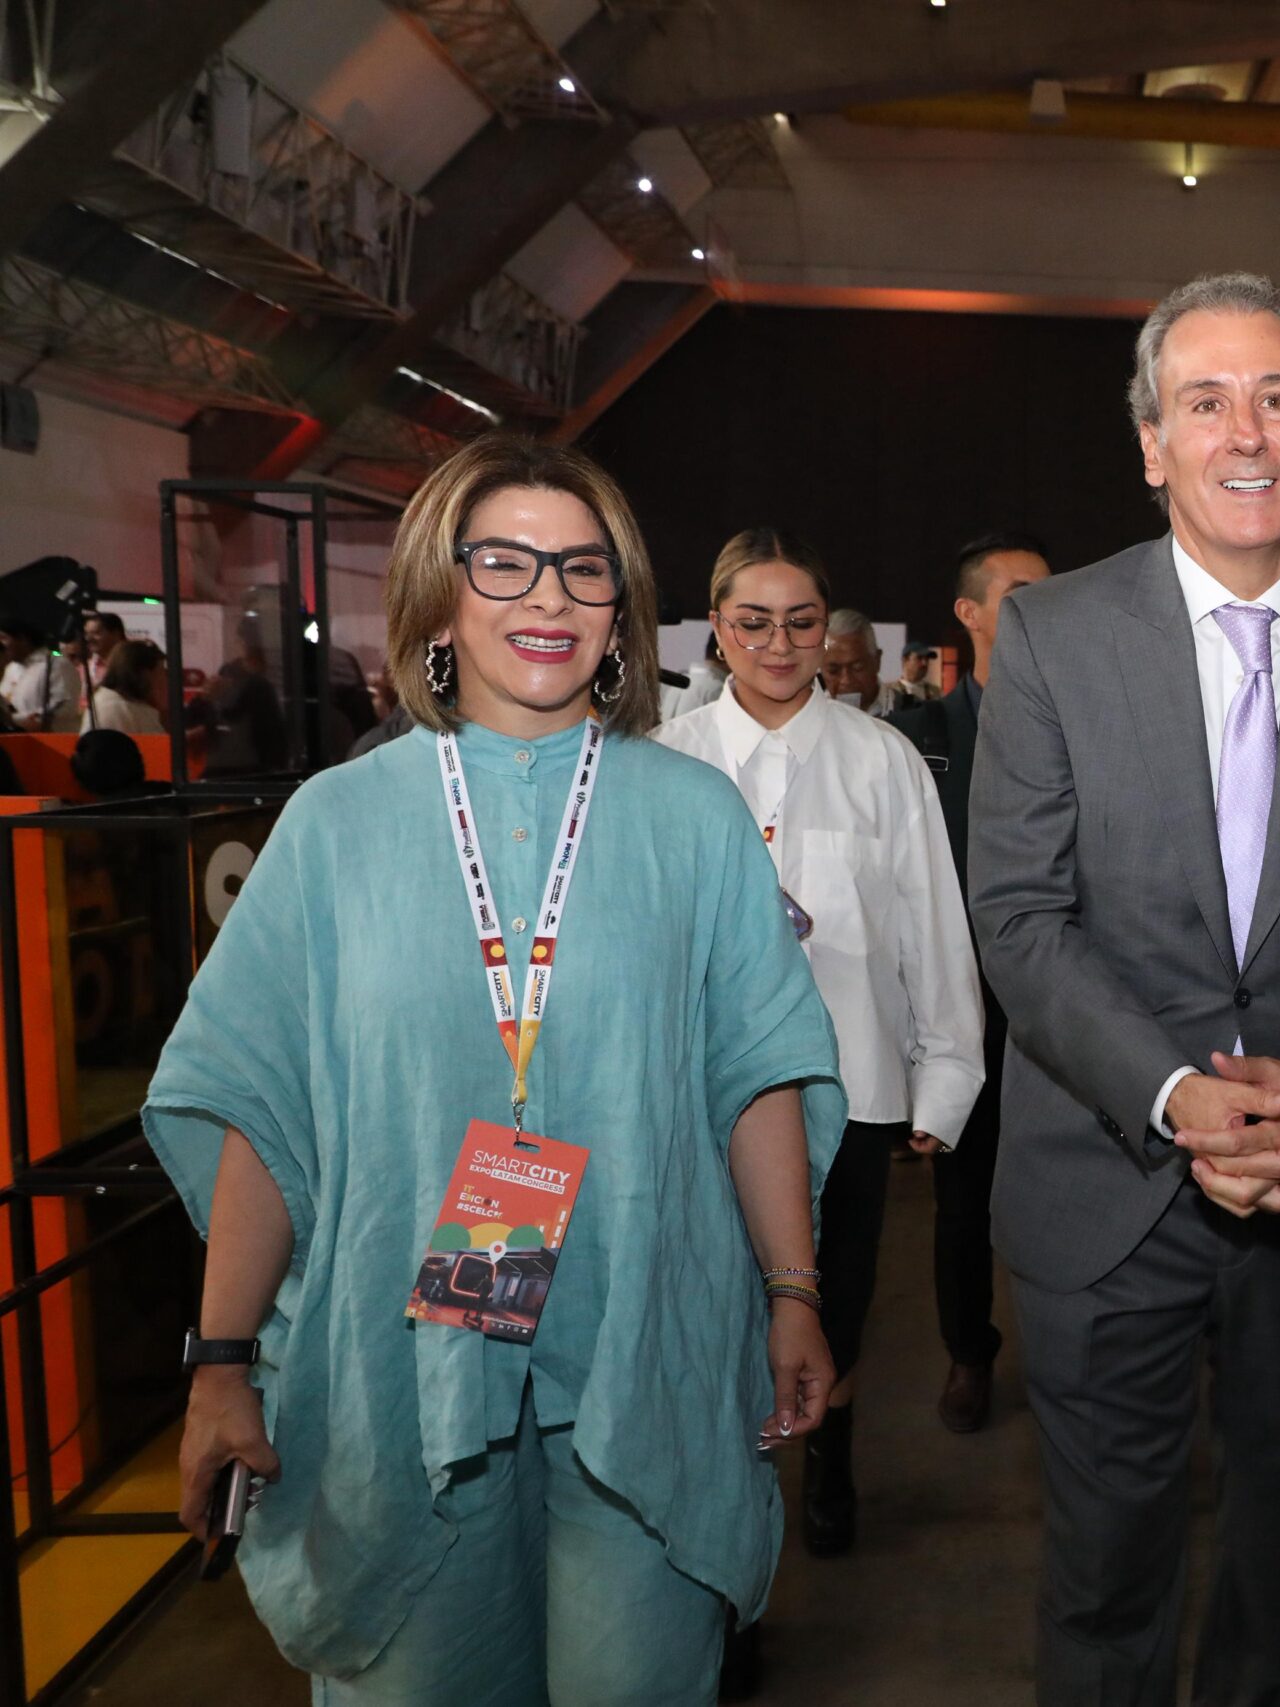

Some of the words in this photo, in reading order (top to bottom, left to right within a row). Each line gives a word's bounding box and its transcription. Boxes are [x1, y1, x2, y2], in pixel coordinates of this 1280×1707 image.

[492, 971, 508, 1017] SMARTCITY
[533, 969, 546, 1016] SMARTCITY
[469, 1164, 491, 1175] EXPO
[492, 1169, 521, 1182] LATAM
[521, 1178, 564, 1194] CONGRESS
[472, 1149, 571, 1185] SMARTCITY
